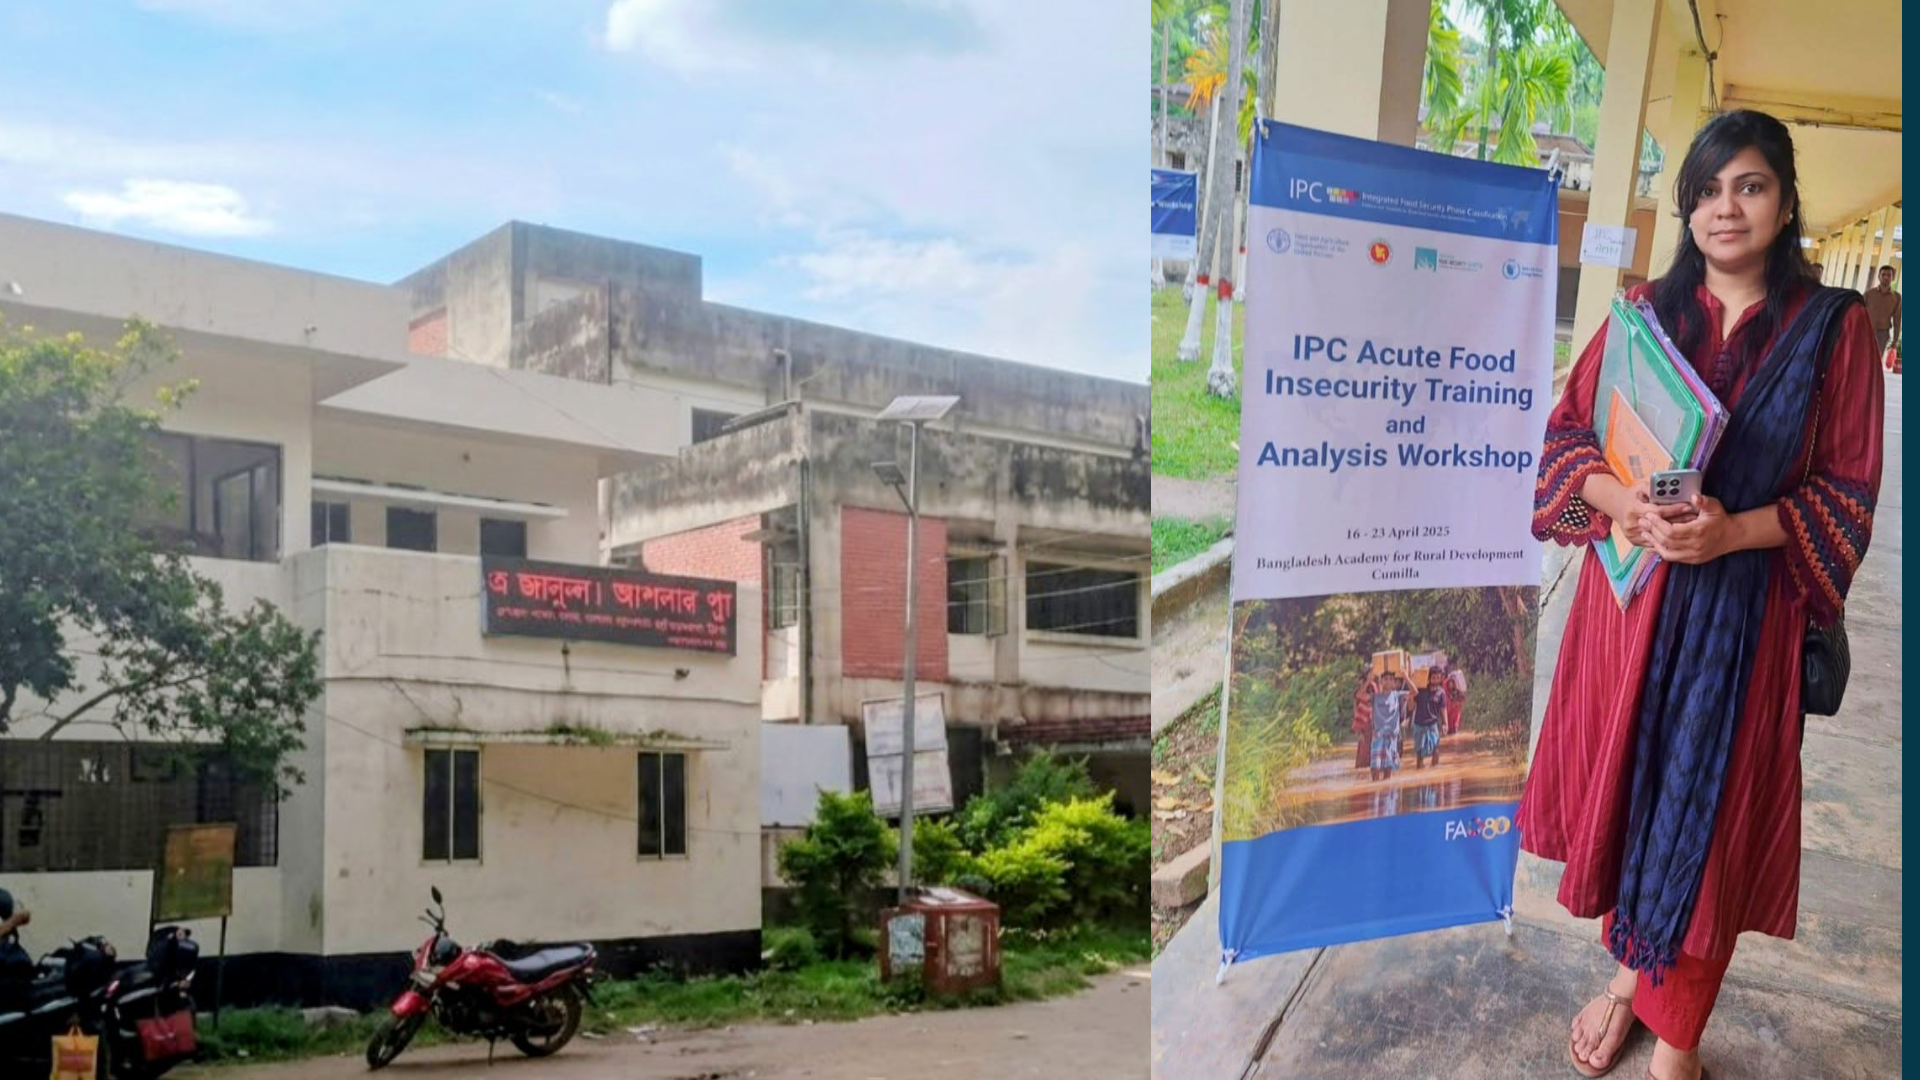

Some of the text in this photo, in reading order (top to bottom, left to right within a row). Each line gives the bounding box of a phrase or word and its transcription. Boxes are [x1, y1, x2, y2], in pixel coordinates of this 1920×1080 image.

[1290, 178, 1322, 203] IPC
[1362, 192, 1399, 206] Integrated
[1419, 200, 1445, 214] Security
[1293, 334, 1516, 373] IPC Acute Food
[1265, 369, 1534, 411] Insecurity Training
[1385, 415, 1426, 434] and
[1257, 441, 1533, 473] Analysis Workshop
[1346, 528, 1360, 540] 16
[1371, 527, 1386, 539] 23
[1388, 526, 1419, 540] April
[1422, 526, 1450, 538] 2025
[1256, 548, 1524, 571] Bangladesh Academy for Rural Development
[1371, 567, 1420, 581] Cumilla
